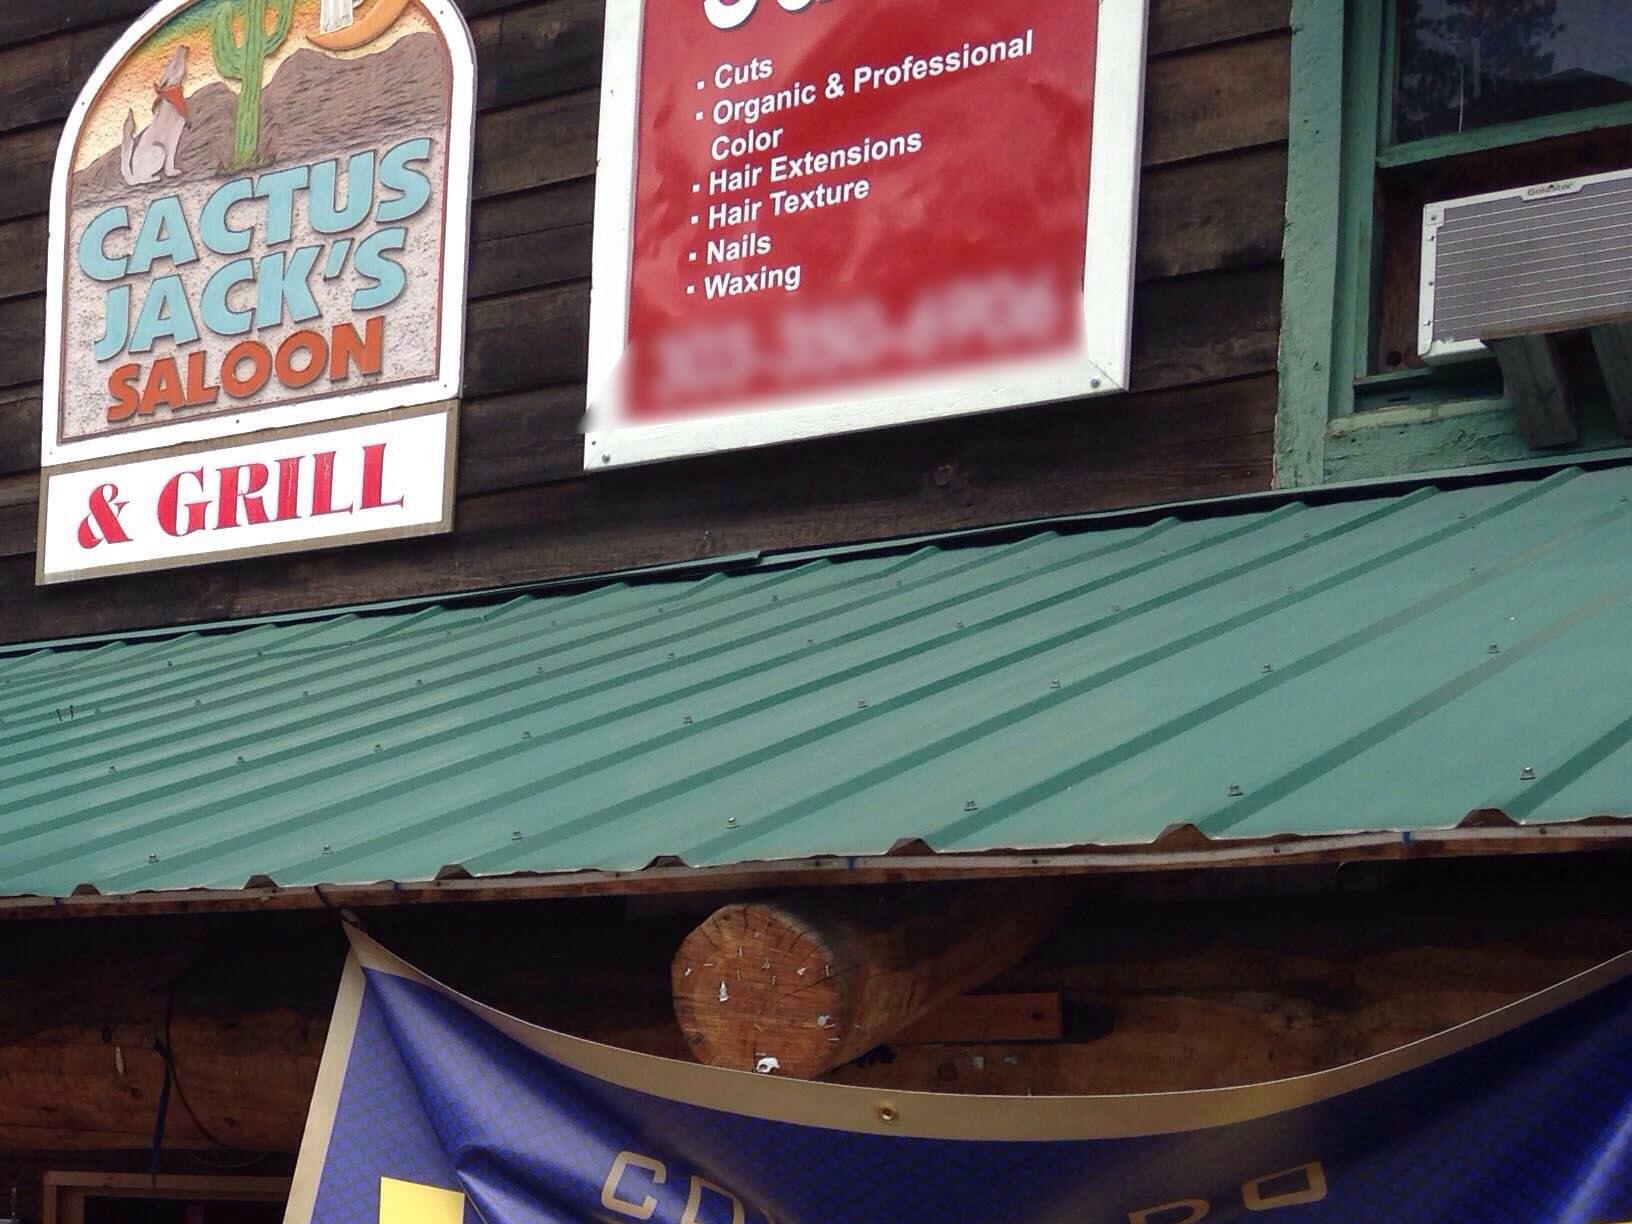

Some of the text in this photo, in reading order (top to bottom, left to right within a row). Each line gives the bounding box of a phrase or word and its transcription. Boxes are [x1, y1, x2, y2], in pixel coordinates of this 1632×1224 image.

[712, 29, 1034, 124] Organic & Professional
[714, 56, 773, 89] Cuts
[708, 131, 923, 196] Hair Extensions
[710, 127, 784, 161] Color
[78, 137, 433, 282] CACTUS
[708, 178, 871, 230] Hair Texture
[706, 232, 772, 265] Nails
[93, 226, 408, 362] JACK'S
[704, 264, 801, 300] Waxing
[106, 316, 386, 424] SALOON
[77, 443, 405, 549] & GRILL
